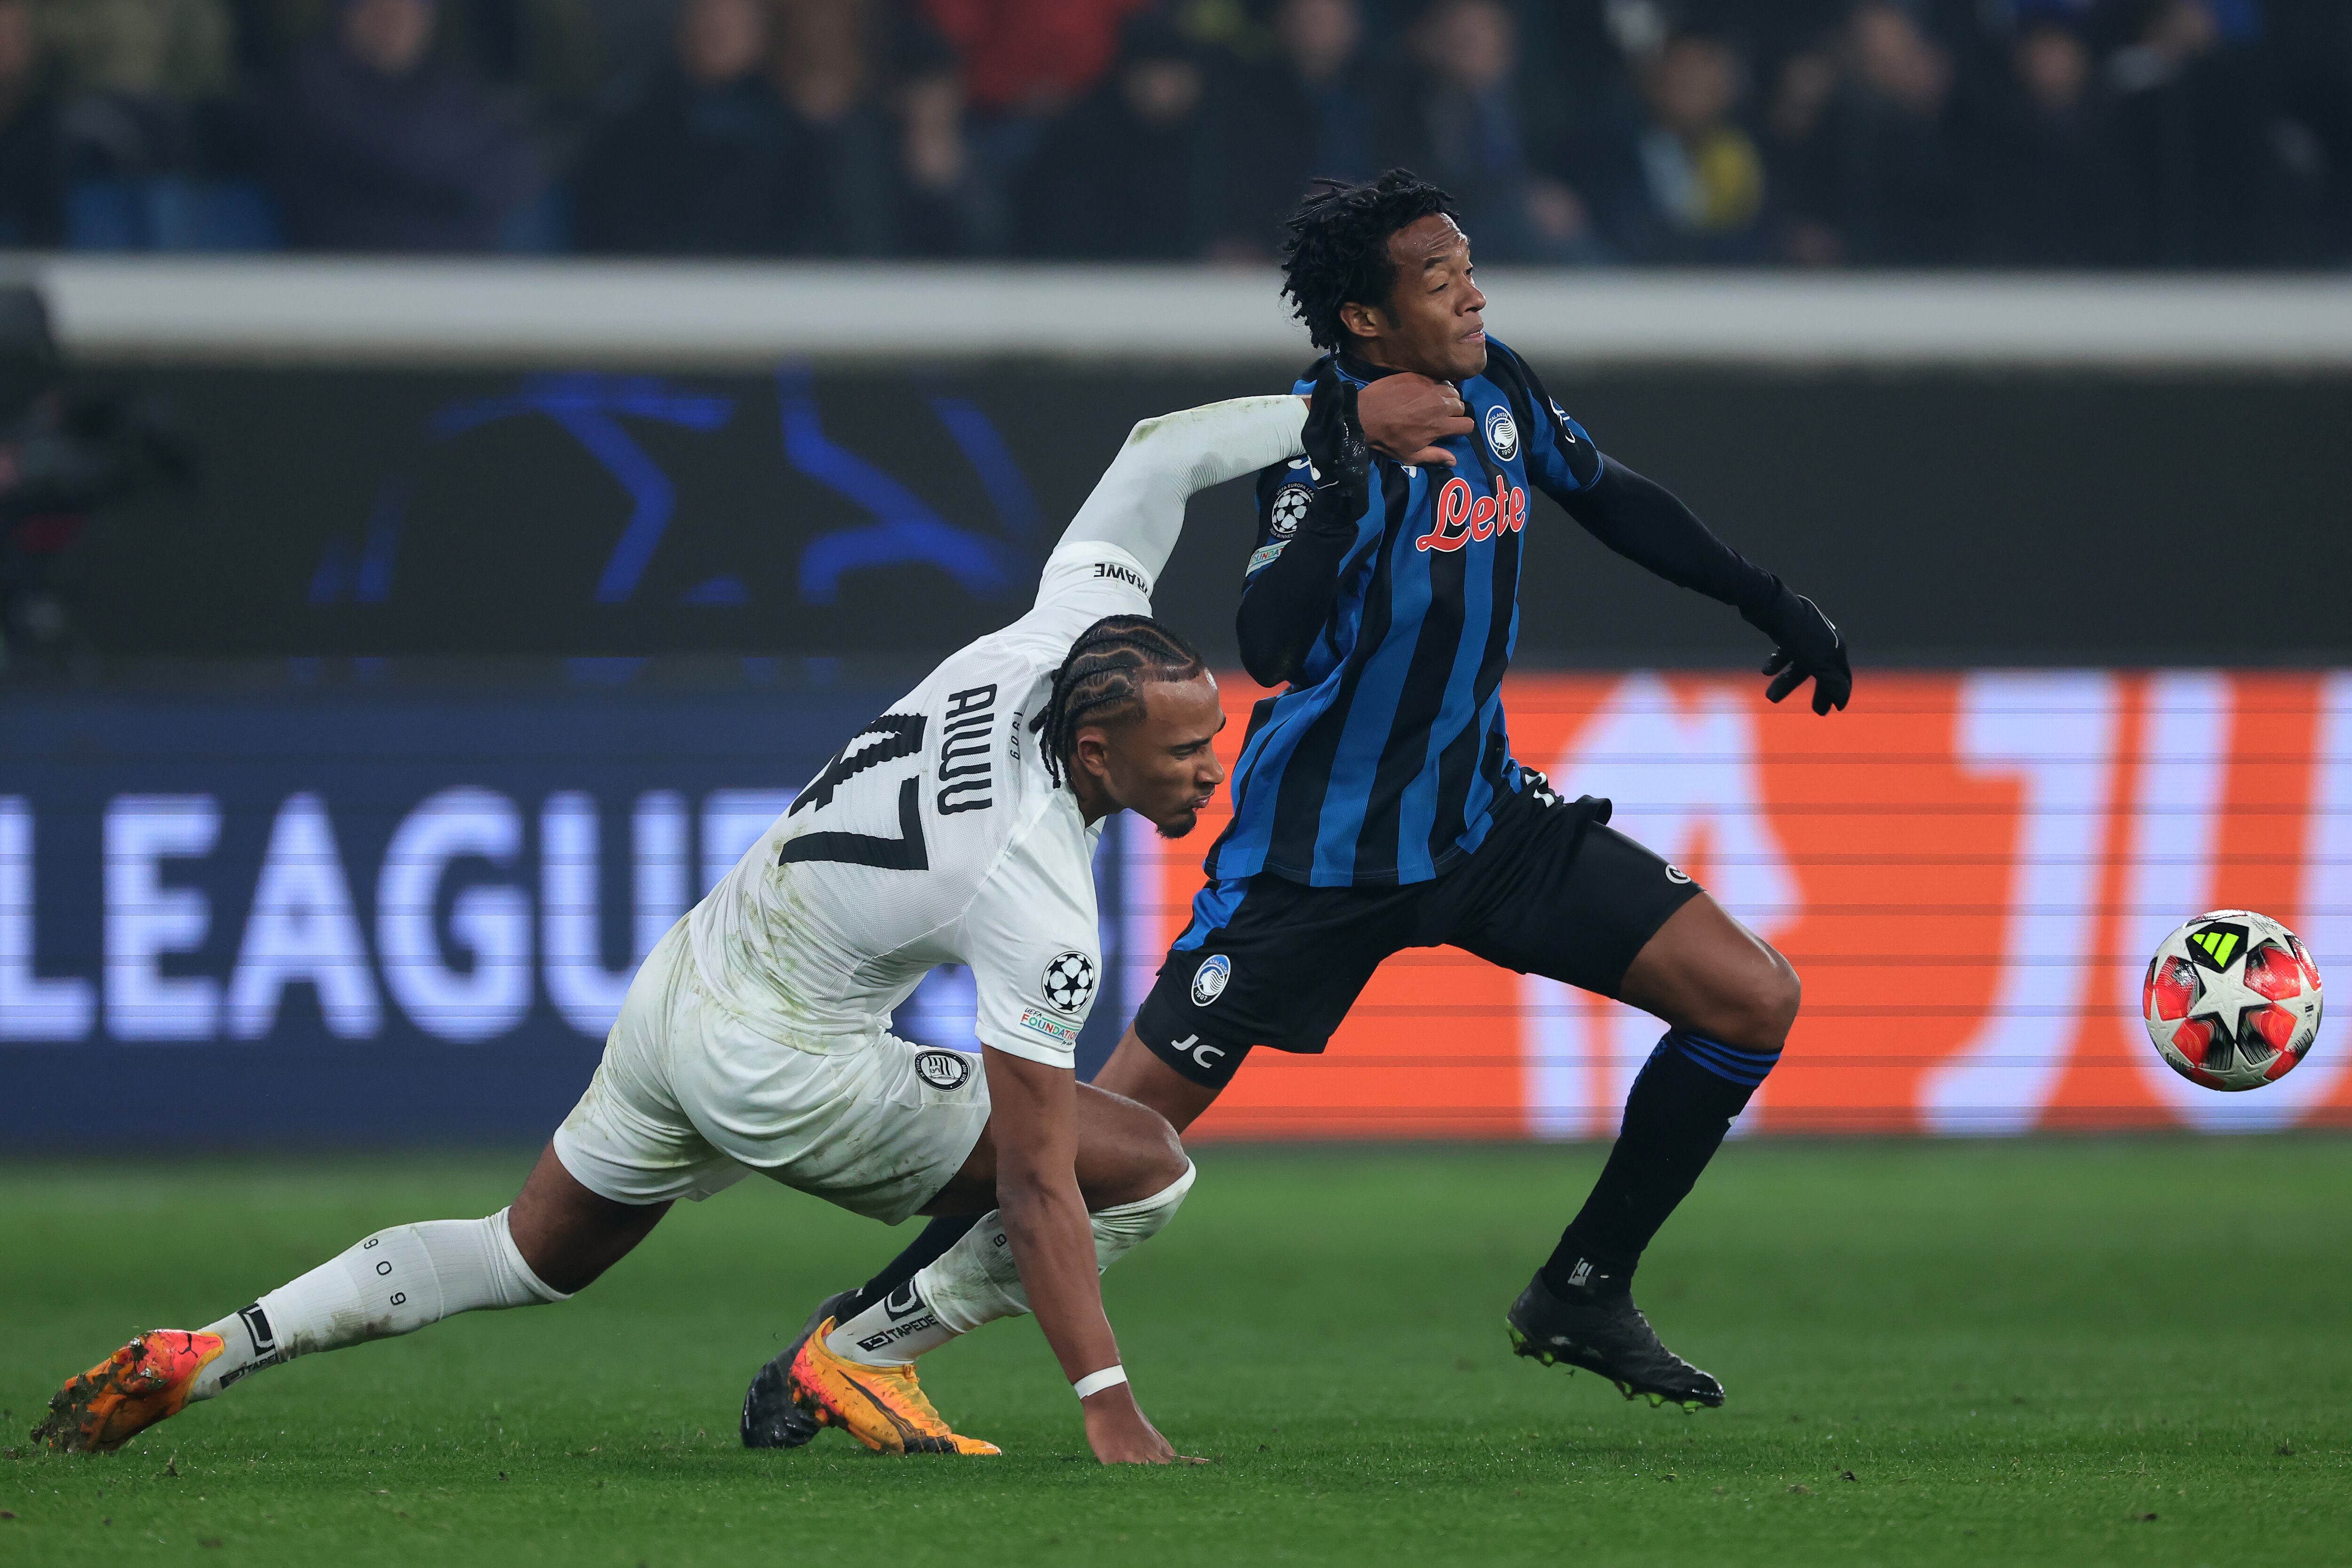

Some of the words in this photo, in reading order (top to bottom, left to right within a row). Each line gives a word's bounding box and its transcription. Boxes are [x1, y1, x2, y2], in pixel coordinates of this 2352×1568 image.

[1502, 446, 1513, 455] 1907
[1276, 486, 1287, 496] UEFA
[1306, 488, 1315, 499] LEA
[1415, 475, 1526, 552] Lete
[1094, 563, 1148, 599] RAWE
[937, 684, 997, 816] AIWU
[1010, 711, 1023, 760] 1909
[779, 713, 929, 871] 47
[1025, 1007, 1042, 1018] UEFA
[1195, 990, 1208, 1001] 1907
[1171, 1034, 1225, 1069] JC
